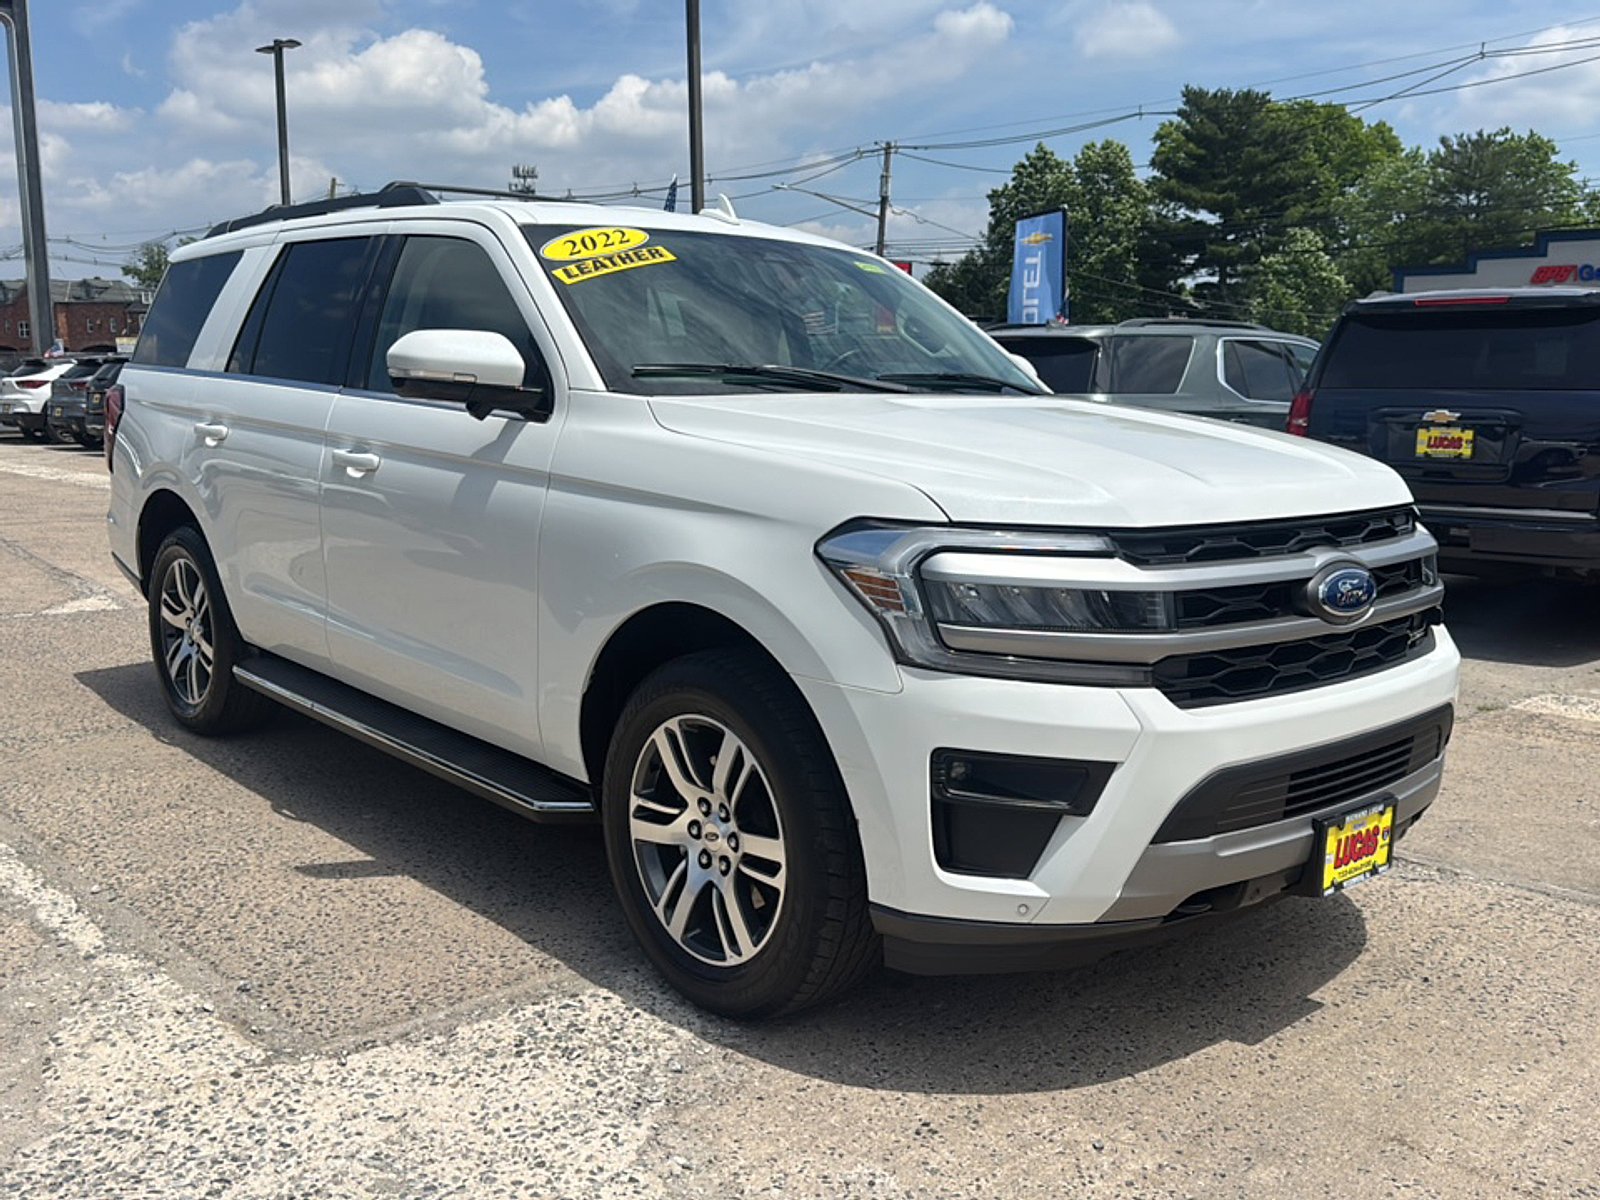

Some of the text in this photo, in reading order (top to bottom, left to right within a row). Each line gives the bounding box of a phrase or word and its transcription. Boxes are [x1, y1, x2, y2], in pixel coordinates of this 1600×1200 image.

[563, 229, 631, 256] 2022
[562, 248, 665, 280] LEATHER
[1427, 435, 1463, 450] LUCAS
[1334, 825, 1380, 870] LUCAS
